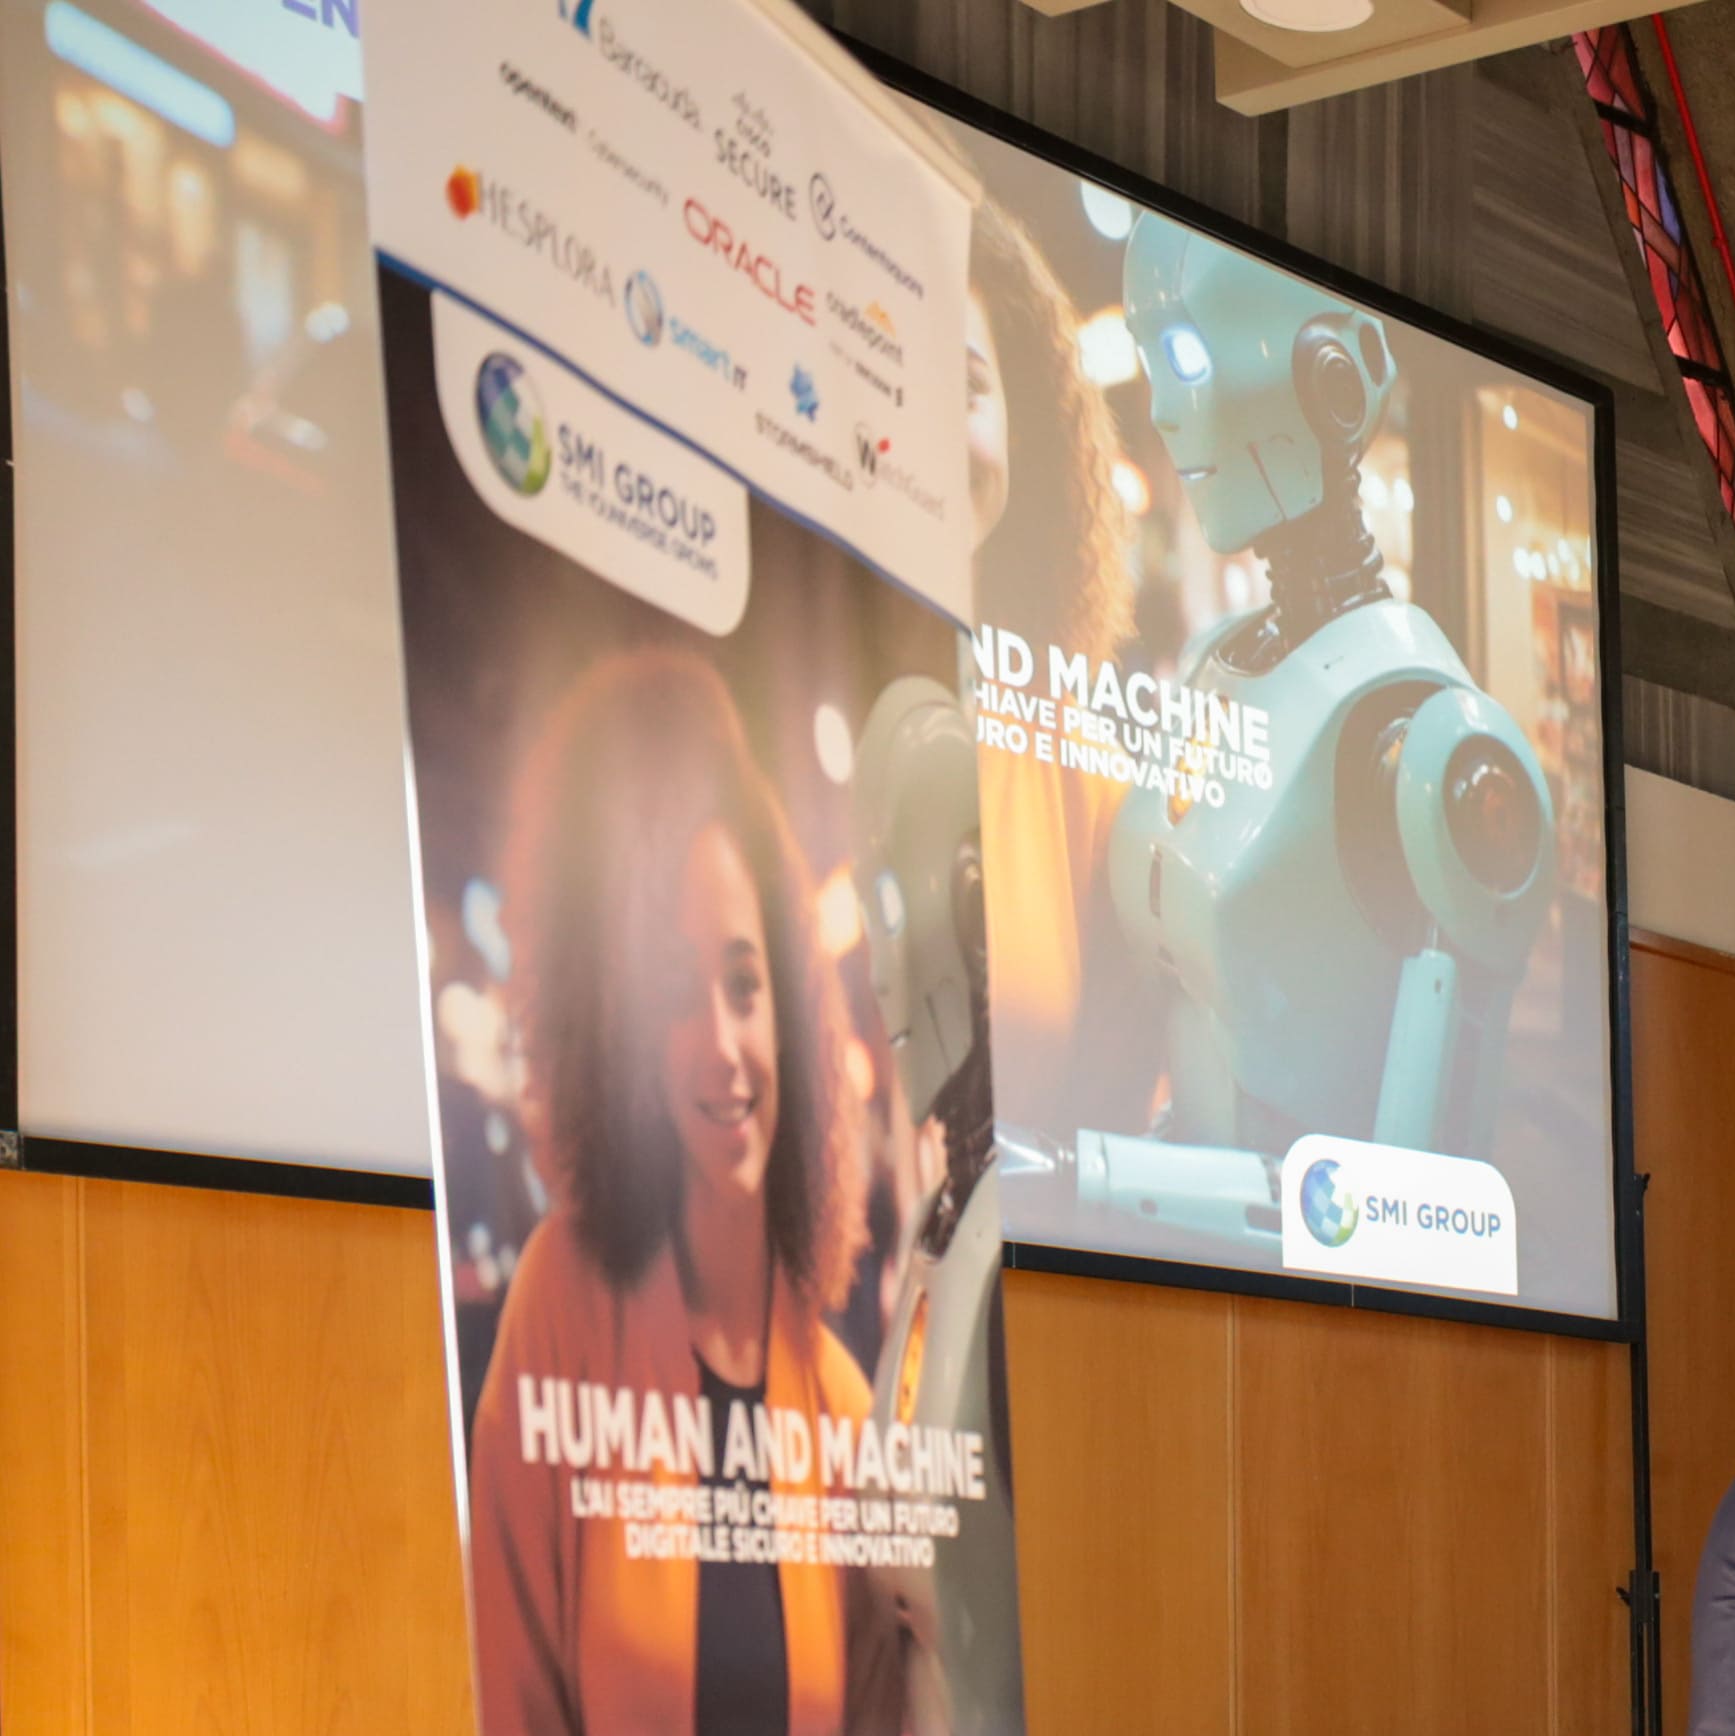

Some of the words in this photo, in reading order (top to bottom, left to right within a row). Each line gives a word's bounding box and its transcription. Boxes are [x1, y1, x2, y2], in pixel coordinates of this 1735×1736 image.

[714, 129, 797, 221] SECURE
[477, 171, 615, 309] HESPLORA
[683, 197, 816, 327] ORACLE
[558, 422, 605, 489] SMI
[613, 462, 716, 547] GROUP
[973, 623, 1033, 687] ND
[1049, 644, 1270, 762] MACHINE
[974, 680, 1056, 730] HIAVE
[1063, 704, 1119, 747] PER
[1123, 726, 1162, 759] UN
[1169, 739, 1273, 791] FUTURO
[1035, 732, 1055, 763] E
[1060, 739, 1225, 809] INNOVATIVO
[1366, 1195, 1407, 1226] SMI
[1417, 1203, 1501, 1238] GROUP
[517, 1373, 714, 1477] HUMAN
[723, 1399, 812, 1484] AND
[820, 1413, 986, 1500] MACHINE
[617, 1481, 713, 1521] SEMPRE
[752, 1490, 819, 1529] CHIAVE
[821, 1498, 858, 1532] PER
[861, 1501, 890, 1534] UN
[894, 1502, 960, 1538] FUTURO
[624, 1523, 731, 1563] DIGITALE
[732, 1529, 803, 1564] SICURO
[821, 1535, 935, 1568] INNOVATIVO
